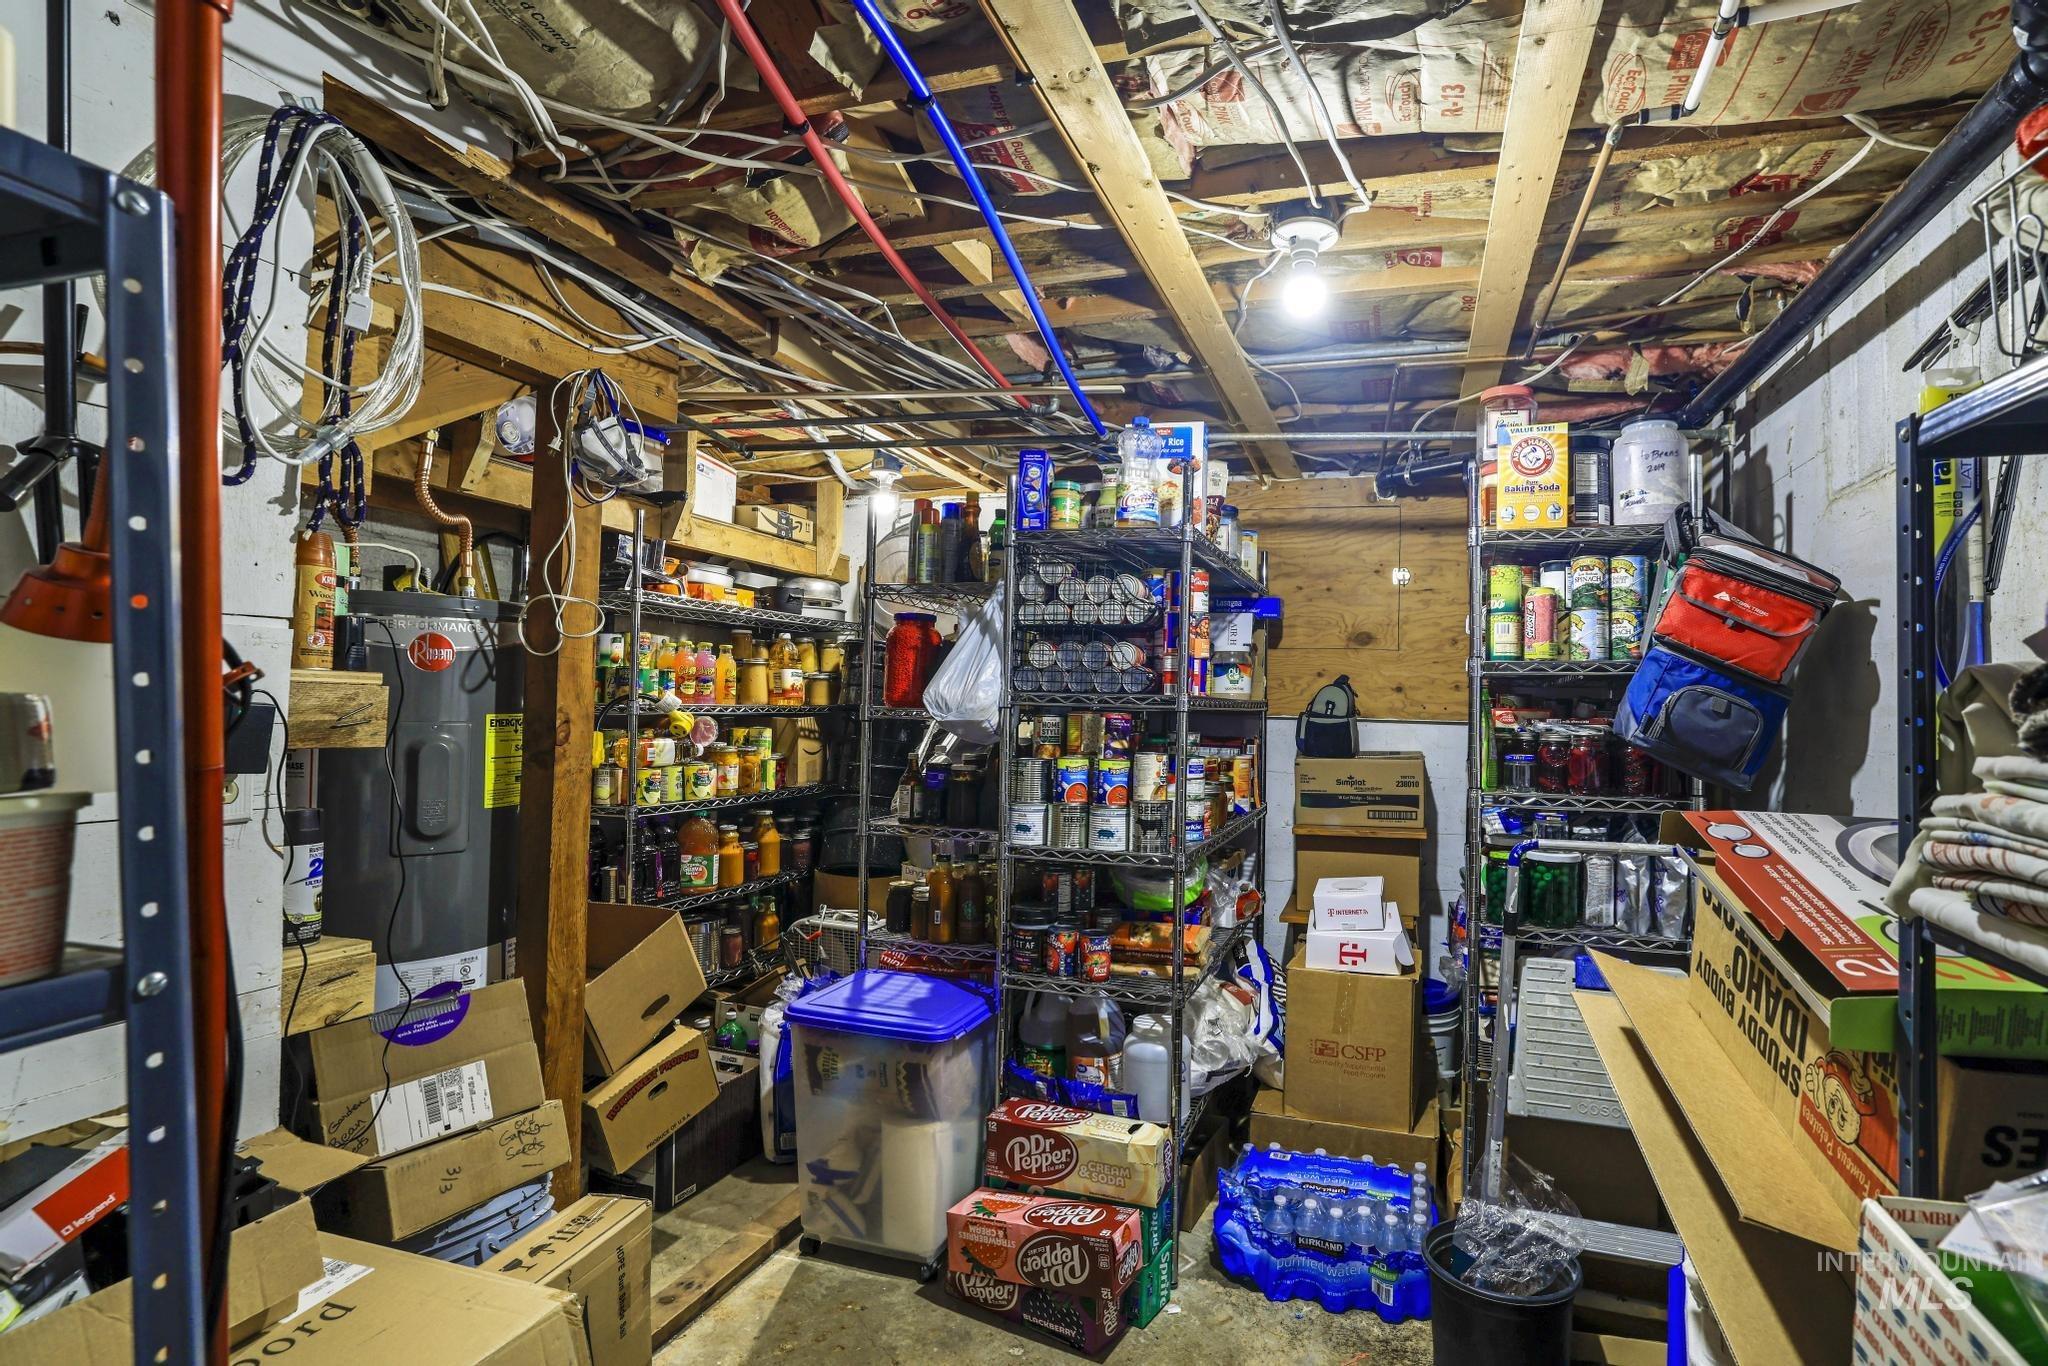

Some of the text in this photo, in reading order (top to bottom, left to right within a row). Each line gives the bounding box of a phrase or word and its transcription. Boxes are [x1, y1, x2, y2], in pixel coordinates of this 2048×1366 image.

[531, 12, 577, 50] Control
[1441, 83, 1466, 118] R-13
[1510, 425, 1556, 434] VALUE SIZE!
[1168, 438, 1184, 446] Rice
[1504, 483, 1560, 495] Baking Soda
[1574, 575, 1602, 583] SPINACH
[1216, 600, 1243, 608] Lasagna
[413, 632, 454, 666] Rheem
[1041, 721, 1060, 729] HOME
[1041, 728, 1060, 736] STYLE
[1336, 778, 1366, 788] Simplot
[1395, 780, 1420, 788] 238010
[1137, 805, 1162, 815] BEEF
[1063, 816, 1086, 824] BEEF
[1696, 951, 1735, 1019] BUDDY
[397, 1019, 455, 1039] quick start guide inside
[413, 1021, 426, 1030] Find
[1341, 1045, 1387, 1062] CSFP
[1737, 1004, 1802, 1098] SPUDDY
[328, 1097, 370, 1134] Garden
[1577, 1103, 1622, 1117] COSC
[988, 1121, 998, 1129] 12
[646, 1129, 671, 1151] PRODUCE
[1031, 1134, 1055, 1154] Dr
[505, 1141, 545, 1160] Seeds
[1013, 1136, 1071, 1174] Pepper
[1801, 1105, 1872, 1199] Famous Potatoes
[1078, 1165, 1126, 1187] & SODA
[1087, 1161, 1131, 1178] CREAM
[72, 1193, 117, 1228] legrand
[958, 1230, 1017, 1249] STRAWBERRIES
[968, 1224, 997, 1236] CREAM
[1297, 1236, 1344, 1252] KIRKLAND
[1022, 1243, 1084, 1285] Pepper
[1276, 1255, 1363, 1278] purified water
[1040, 1266, 1065, 1287] Dr
[1160, 1252, 1171, 1308] Sprite
[1022, 1312, 1077, 1338] BLACKBERRY
